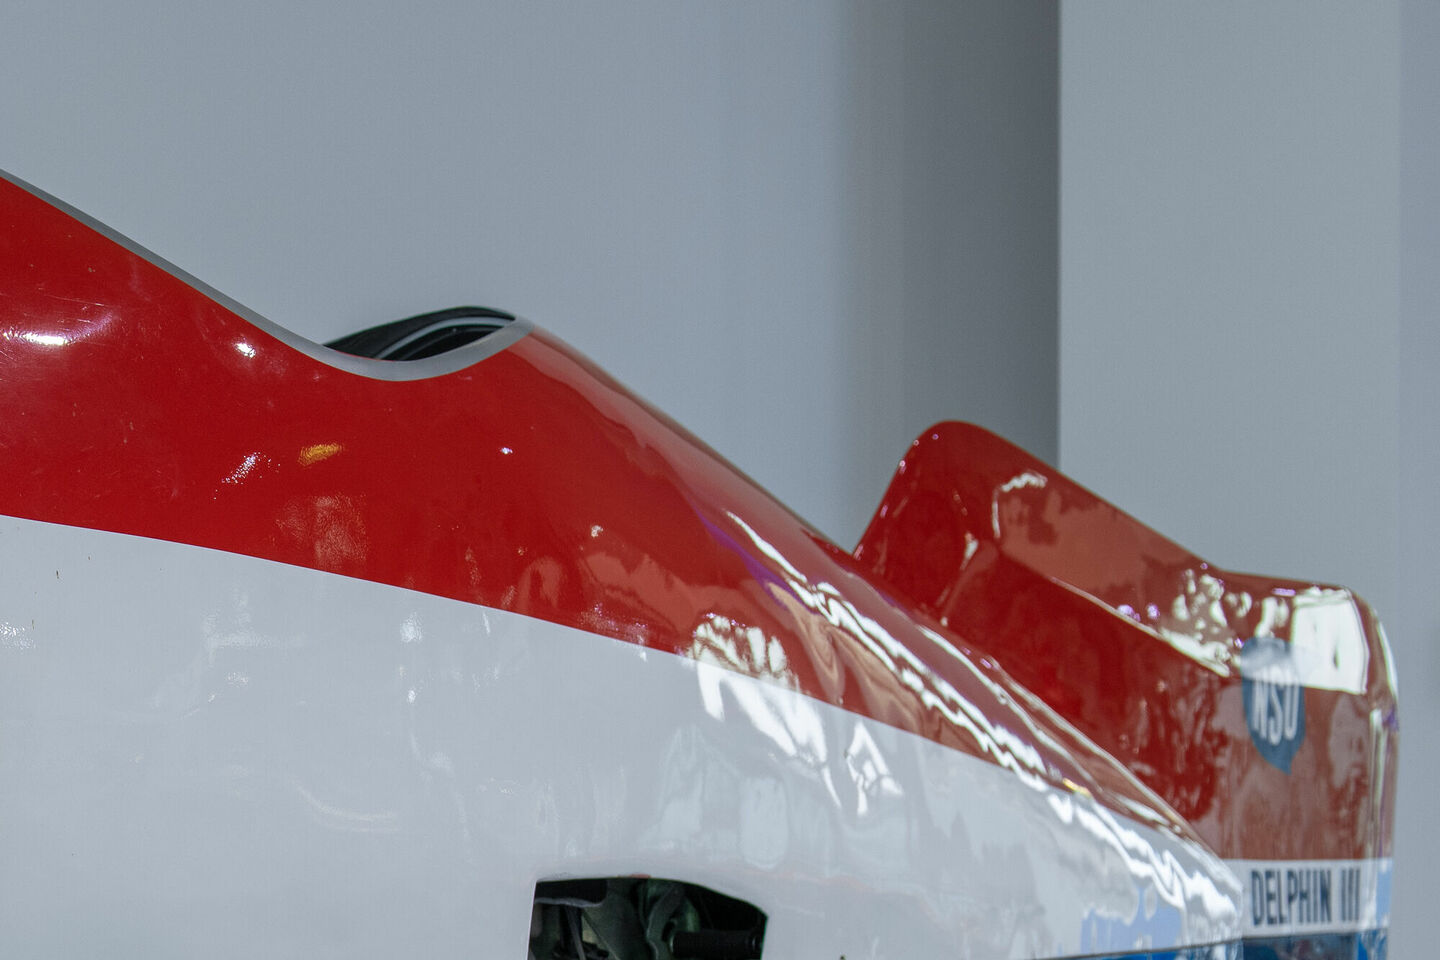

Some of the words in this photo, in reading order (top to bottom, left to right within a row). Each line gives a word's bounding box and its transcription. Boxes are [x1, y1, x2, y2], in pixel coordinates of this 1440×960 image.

[1250, 667, 1300, 746] NSU
[1250, 868, 1332, 927] DELPHIN
[1339, 868, 1361, 923] III
